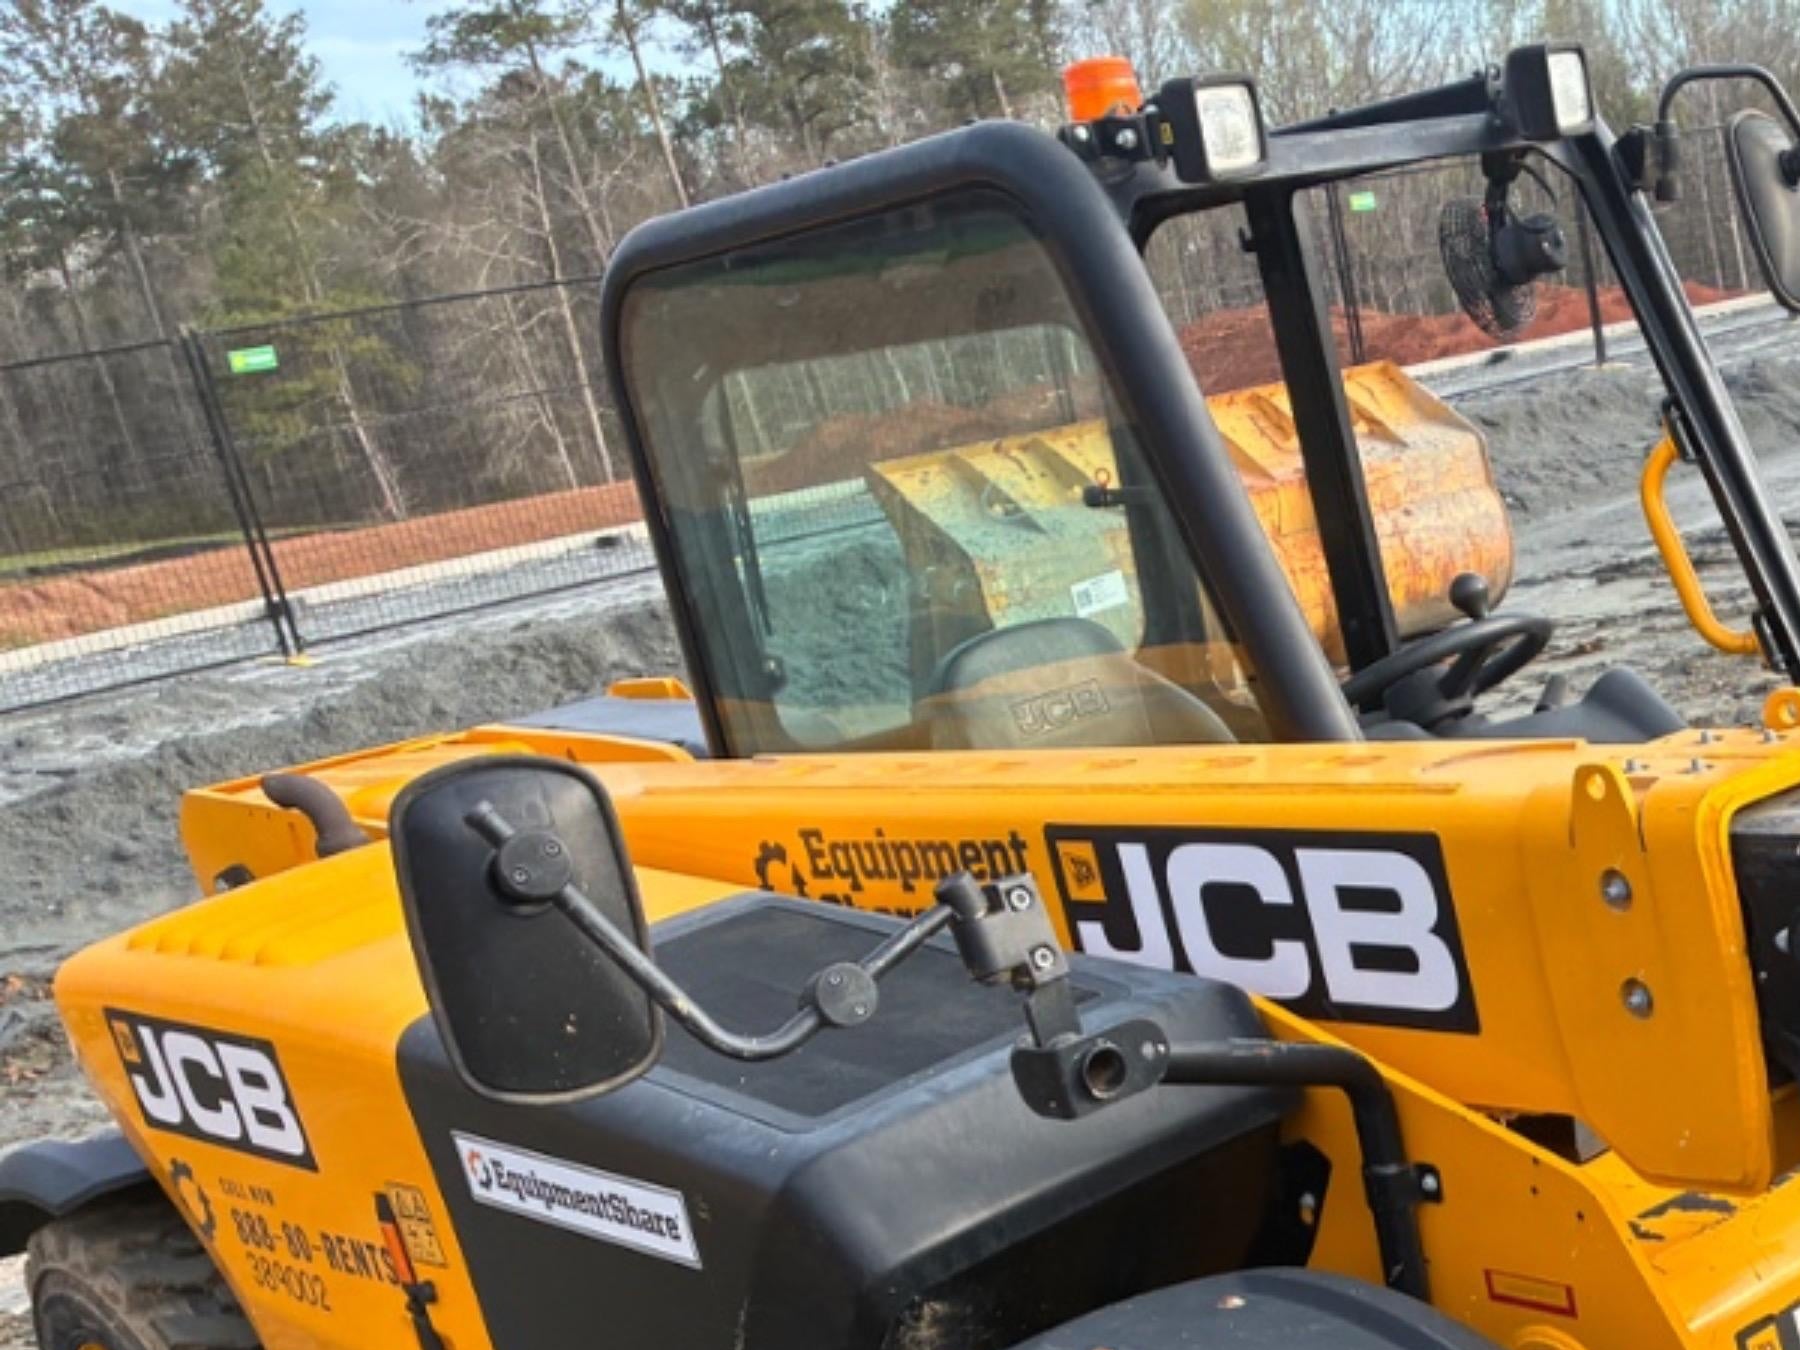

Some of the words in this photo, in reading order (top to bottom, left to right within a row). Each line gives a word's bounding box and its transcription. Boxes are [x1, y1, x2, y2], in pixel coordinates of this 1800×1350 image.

[798, 828, 1028, 895] Equipment
[1076, 841, 1460, 1012] JCB
[131, 1024, 304, 1156] JCB
[489, 1157, 682, 1241] EquipmentShare
[230, 1207, 401, 1285] 888-80-RENTS
